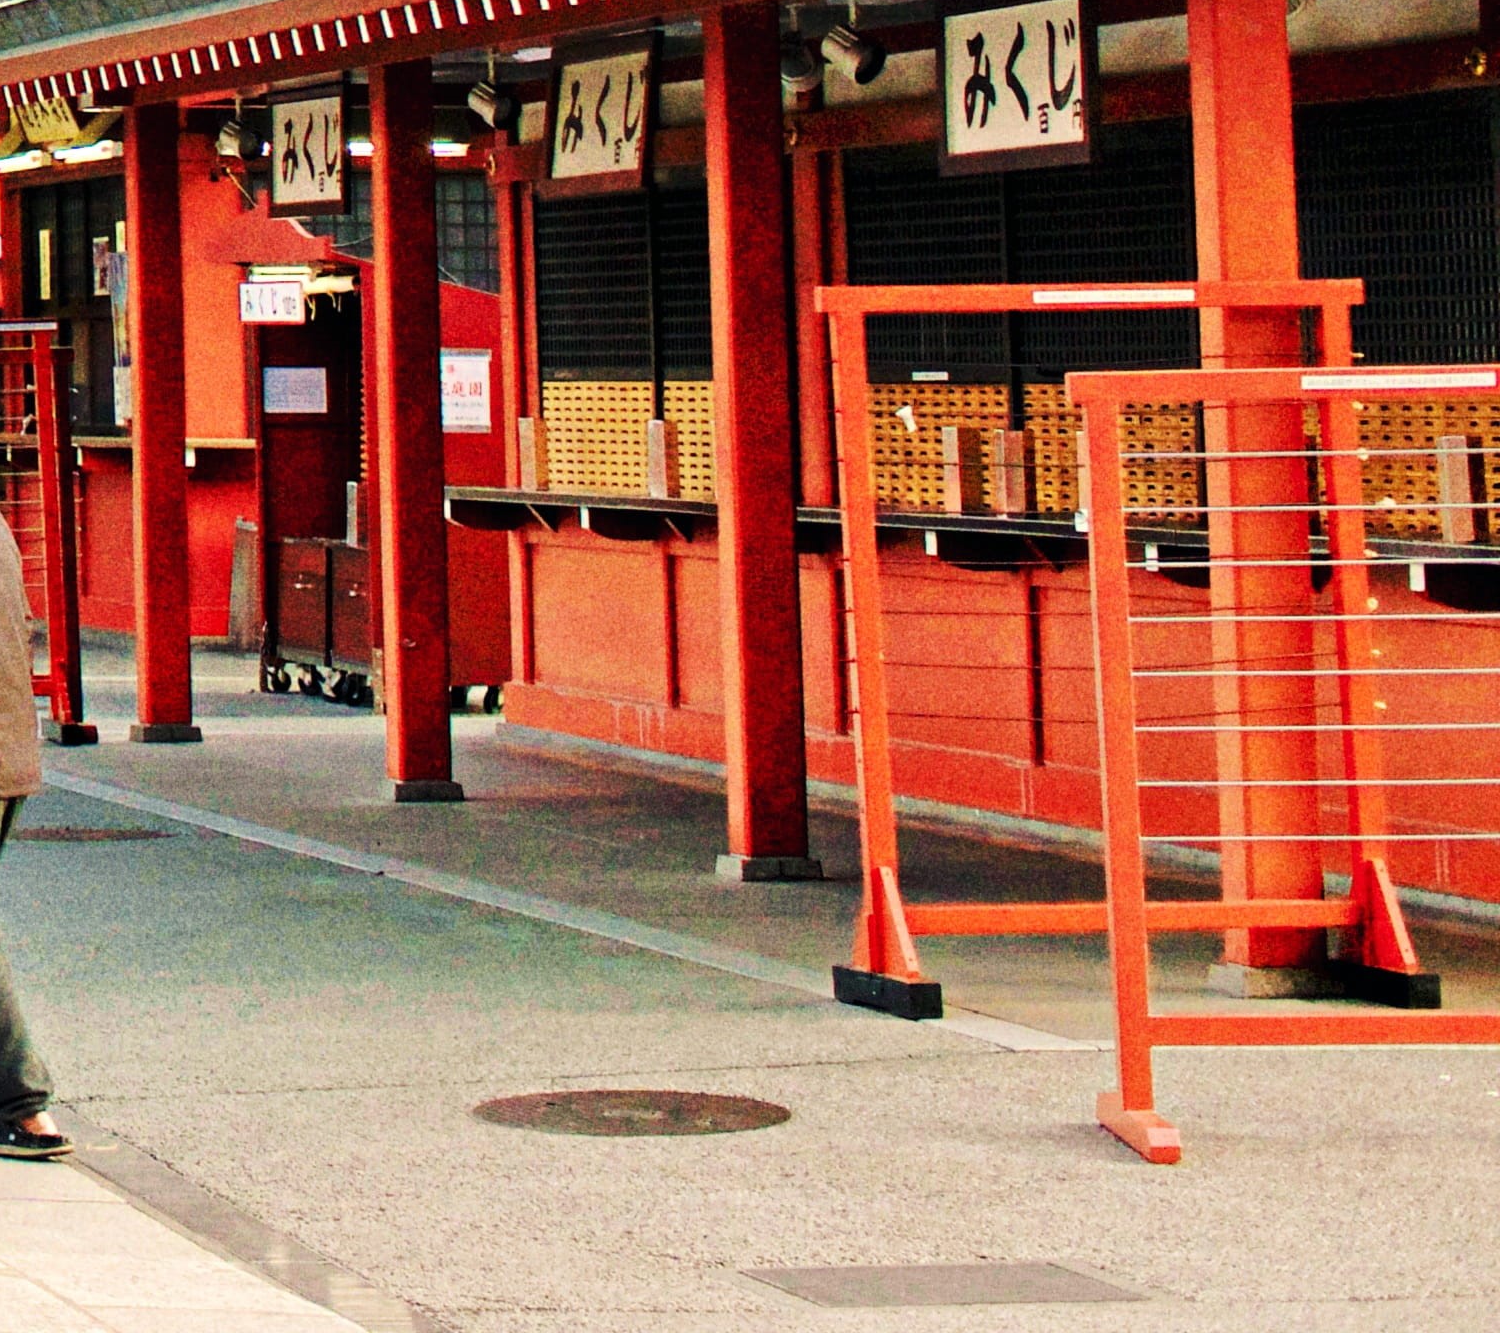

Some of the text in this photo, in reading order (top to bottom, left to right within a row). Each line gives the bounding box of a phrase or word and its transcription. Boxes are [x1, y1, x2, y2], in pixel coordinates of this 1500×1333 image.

[964, 17, 1077, 129] みくじ
[282, 112, 339, 185] みくじ
